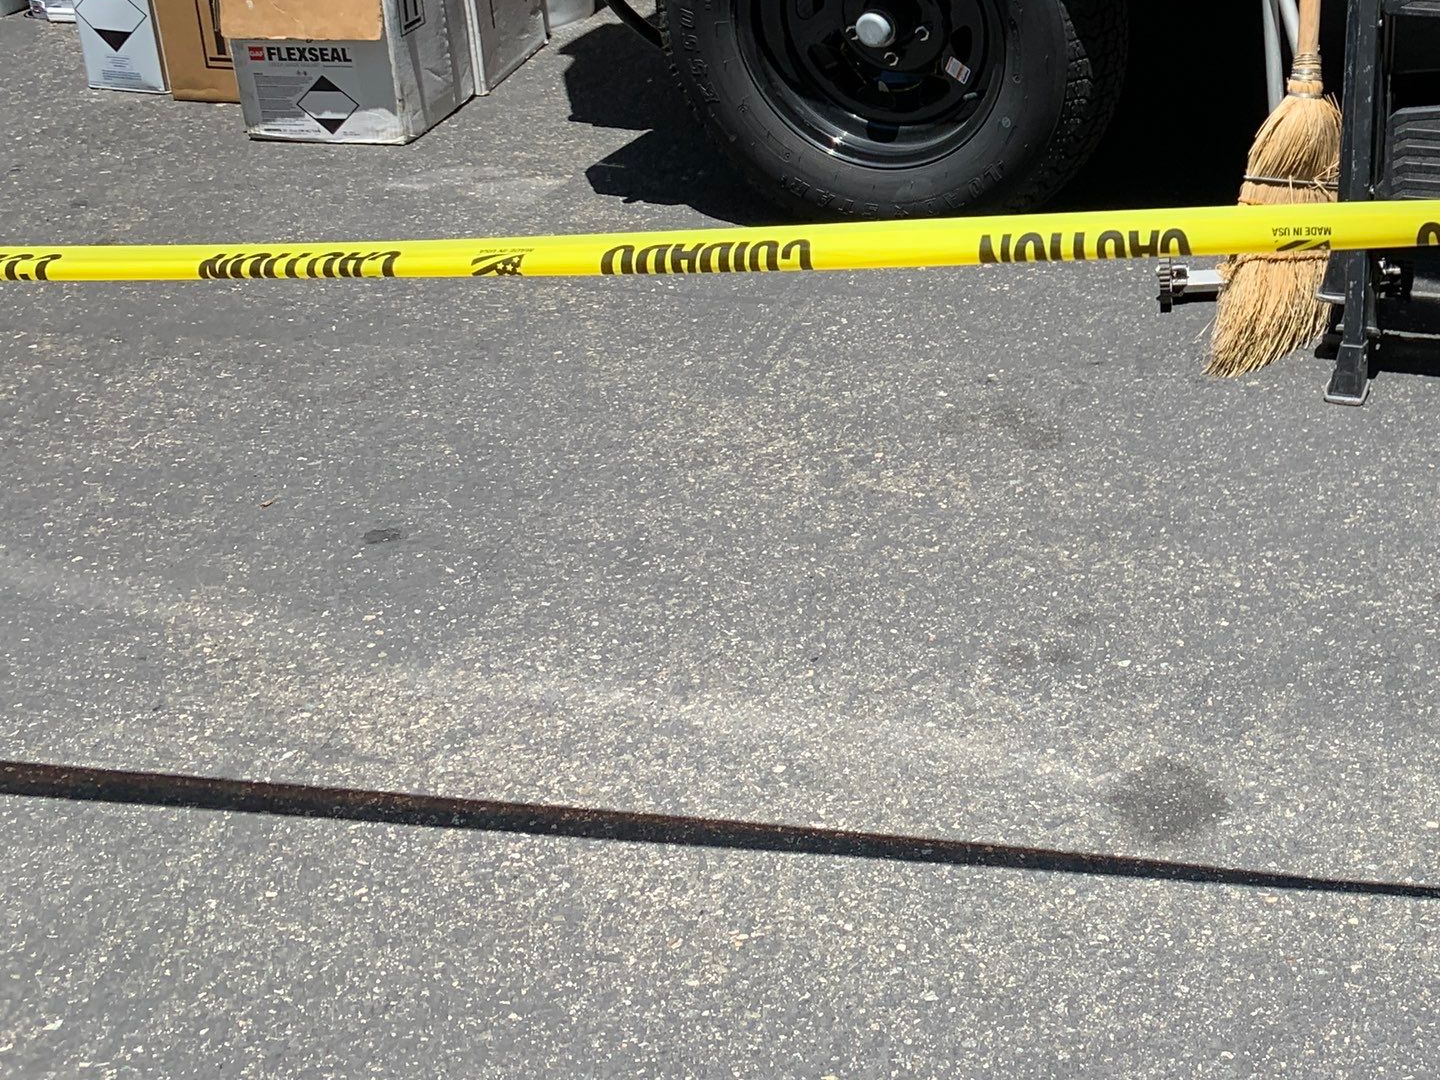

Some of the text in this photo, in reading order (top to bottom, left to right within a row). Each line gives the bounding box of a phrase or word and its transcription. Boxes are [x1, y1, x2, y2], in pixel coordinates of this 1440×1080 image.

[266, 46, 353, 63] FLEXSEAL
[1272, 227, 1331, 236] MADE IN USA
[600, 239, 813, 276] CUIDADO
[979, 229, 1192, 263] CAUTION
